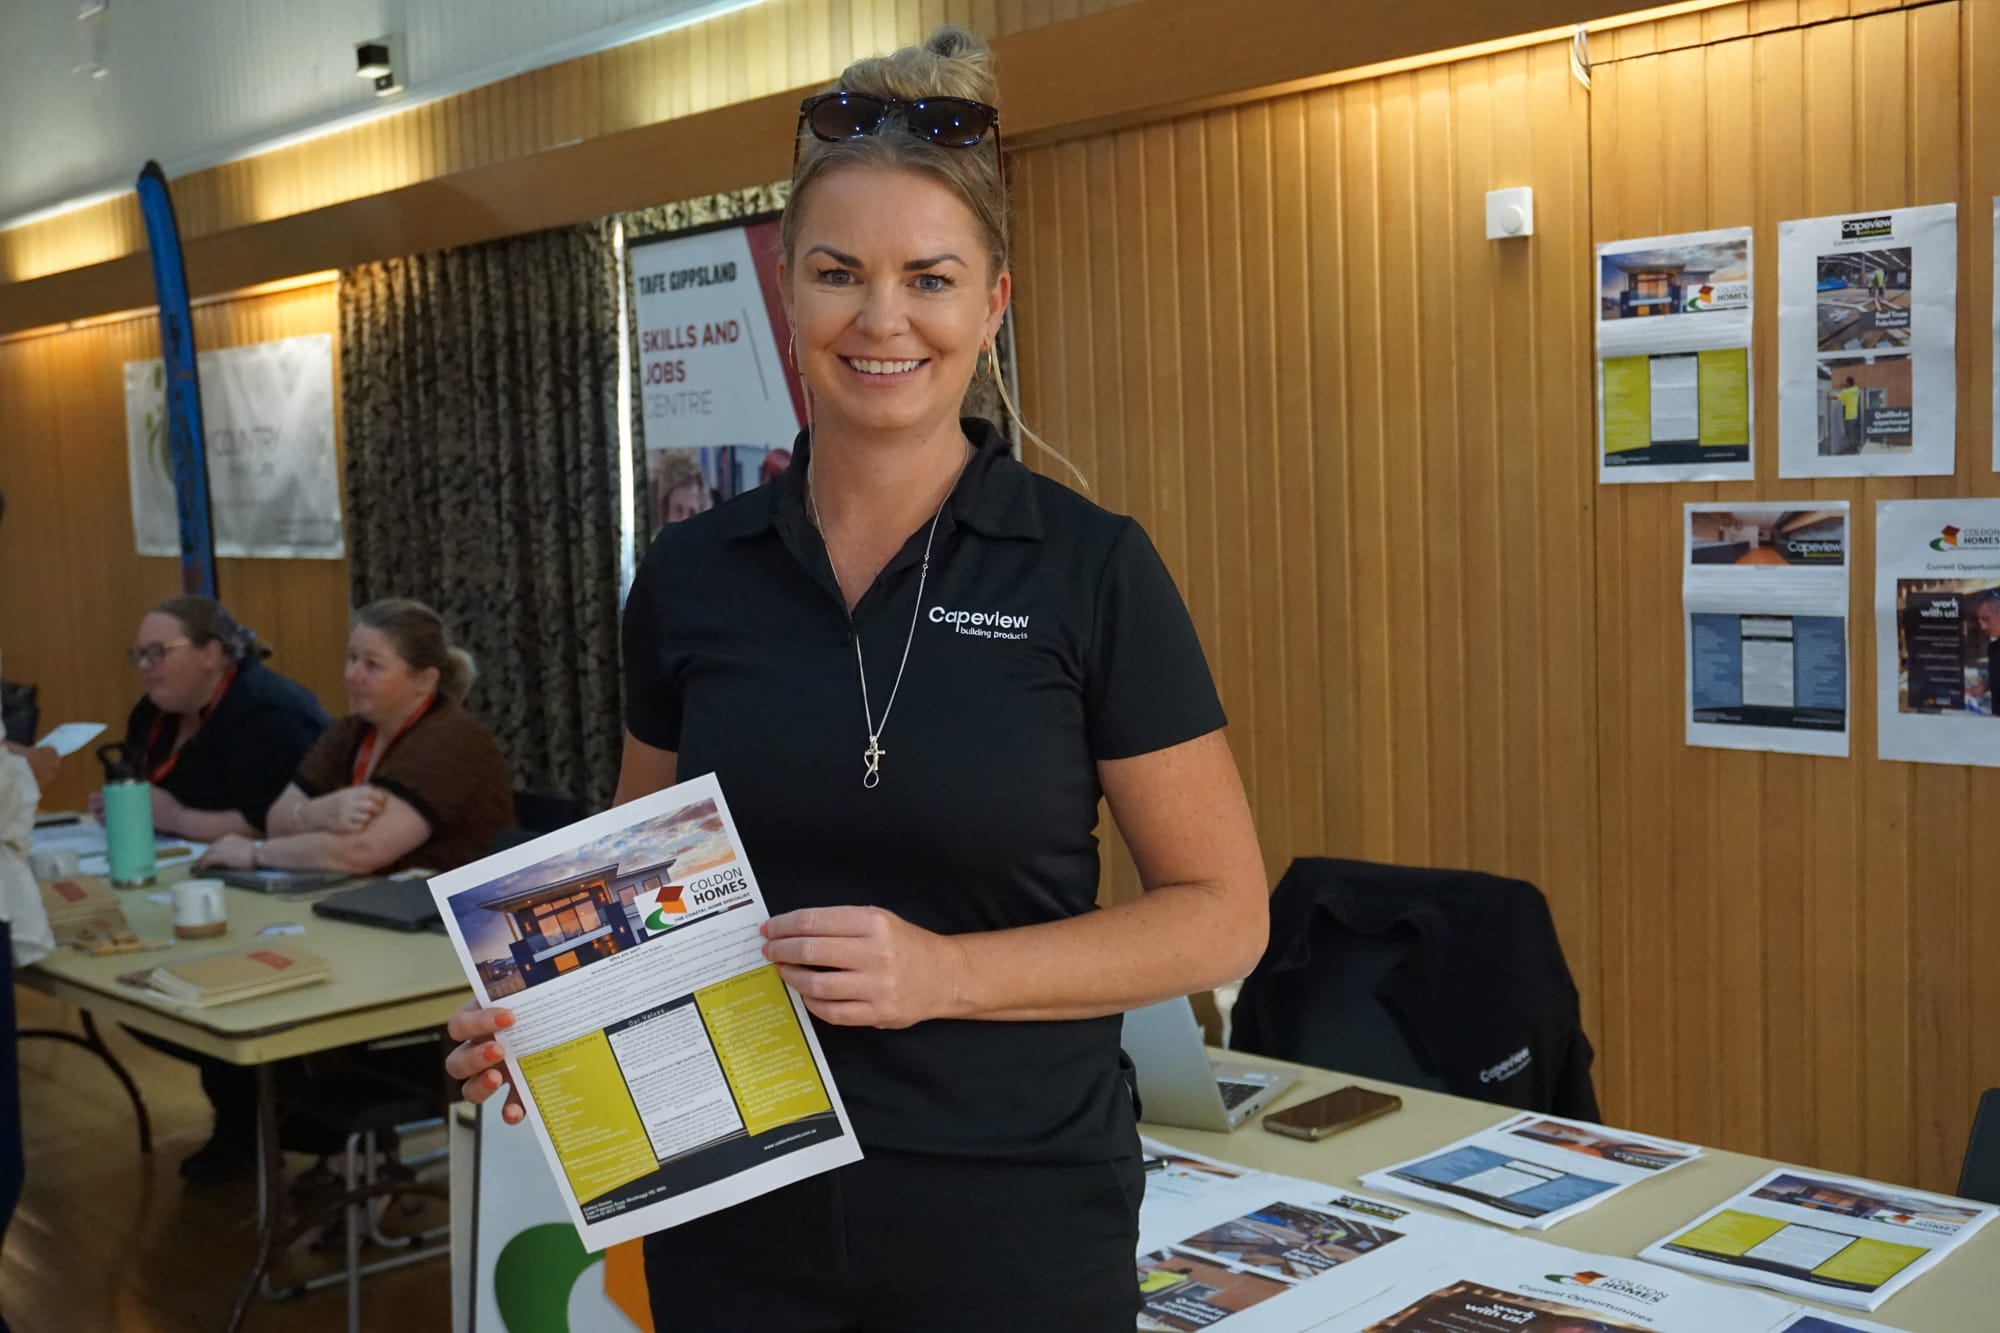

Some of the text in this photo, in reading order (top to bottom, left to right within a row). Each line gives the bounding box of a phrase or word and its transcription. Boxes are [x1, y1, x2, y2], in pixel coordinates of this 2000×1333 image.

[1842, 219, 1891, 236] Capeview
[639, 261, 736, 296] TAFE GIPPSLAND
[1717, 292, 1748, 301] HOMES
[642, 319, 739, 353] SKILLS AND
[644, 360, 686, 385] JOBS
[1788, 541, 1841, 558] Capeview
[1963, 537, 2000, 545] HOMES
[1920, 608, 1943, 618] with
[1932, 597, 1957, 608] work
[928, 606, 1029, 633] Capeview
[960, 626, 1029, 640] building products
[690, 867, 743, 893] COLDON
[694, 879, 747, 905] HOMES
[628, 1009, 664, 1026] Our Values
[1480, 1047, 1530, 1082] Capeview
[1340, 1195, 1404, 1217] Capeview
[1601, 1282, 1660, 1303] HOMES
[1608, 1278, 1669, 1299] COLDON
[1465, 1303, 1500, 1317] with
[1493, 1304, 1536, 1317] work
[1518, 1284, 1565, 1297] Current
[1567, 1293, 1654, 1323] Opportunities
